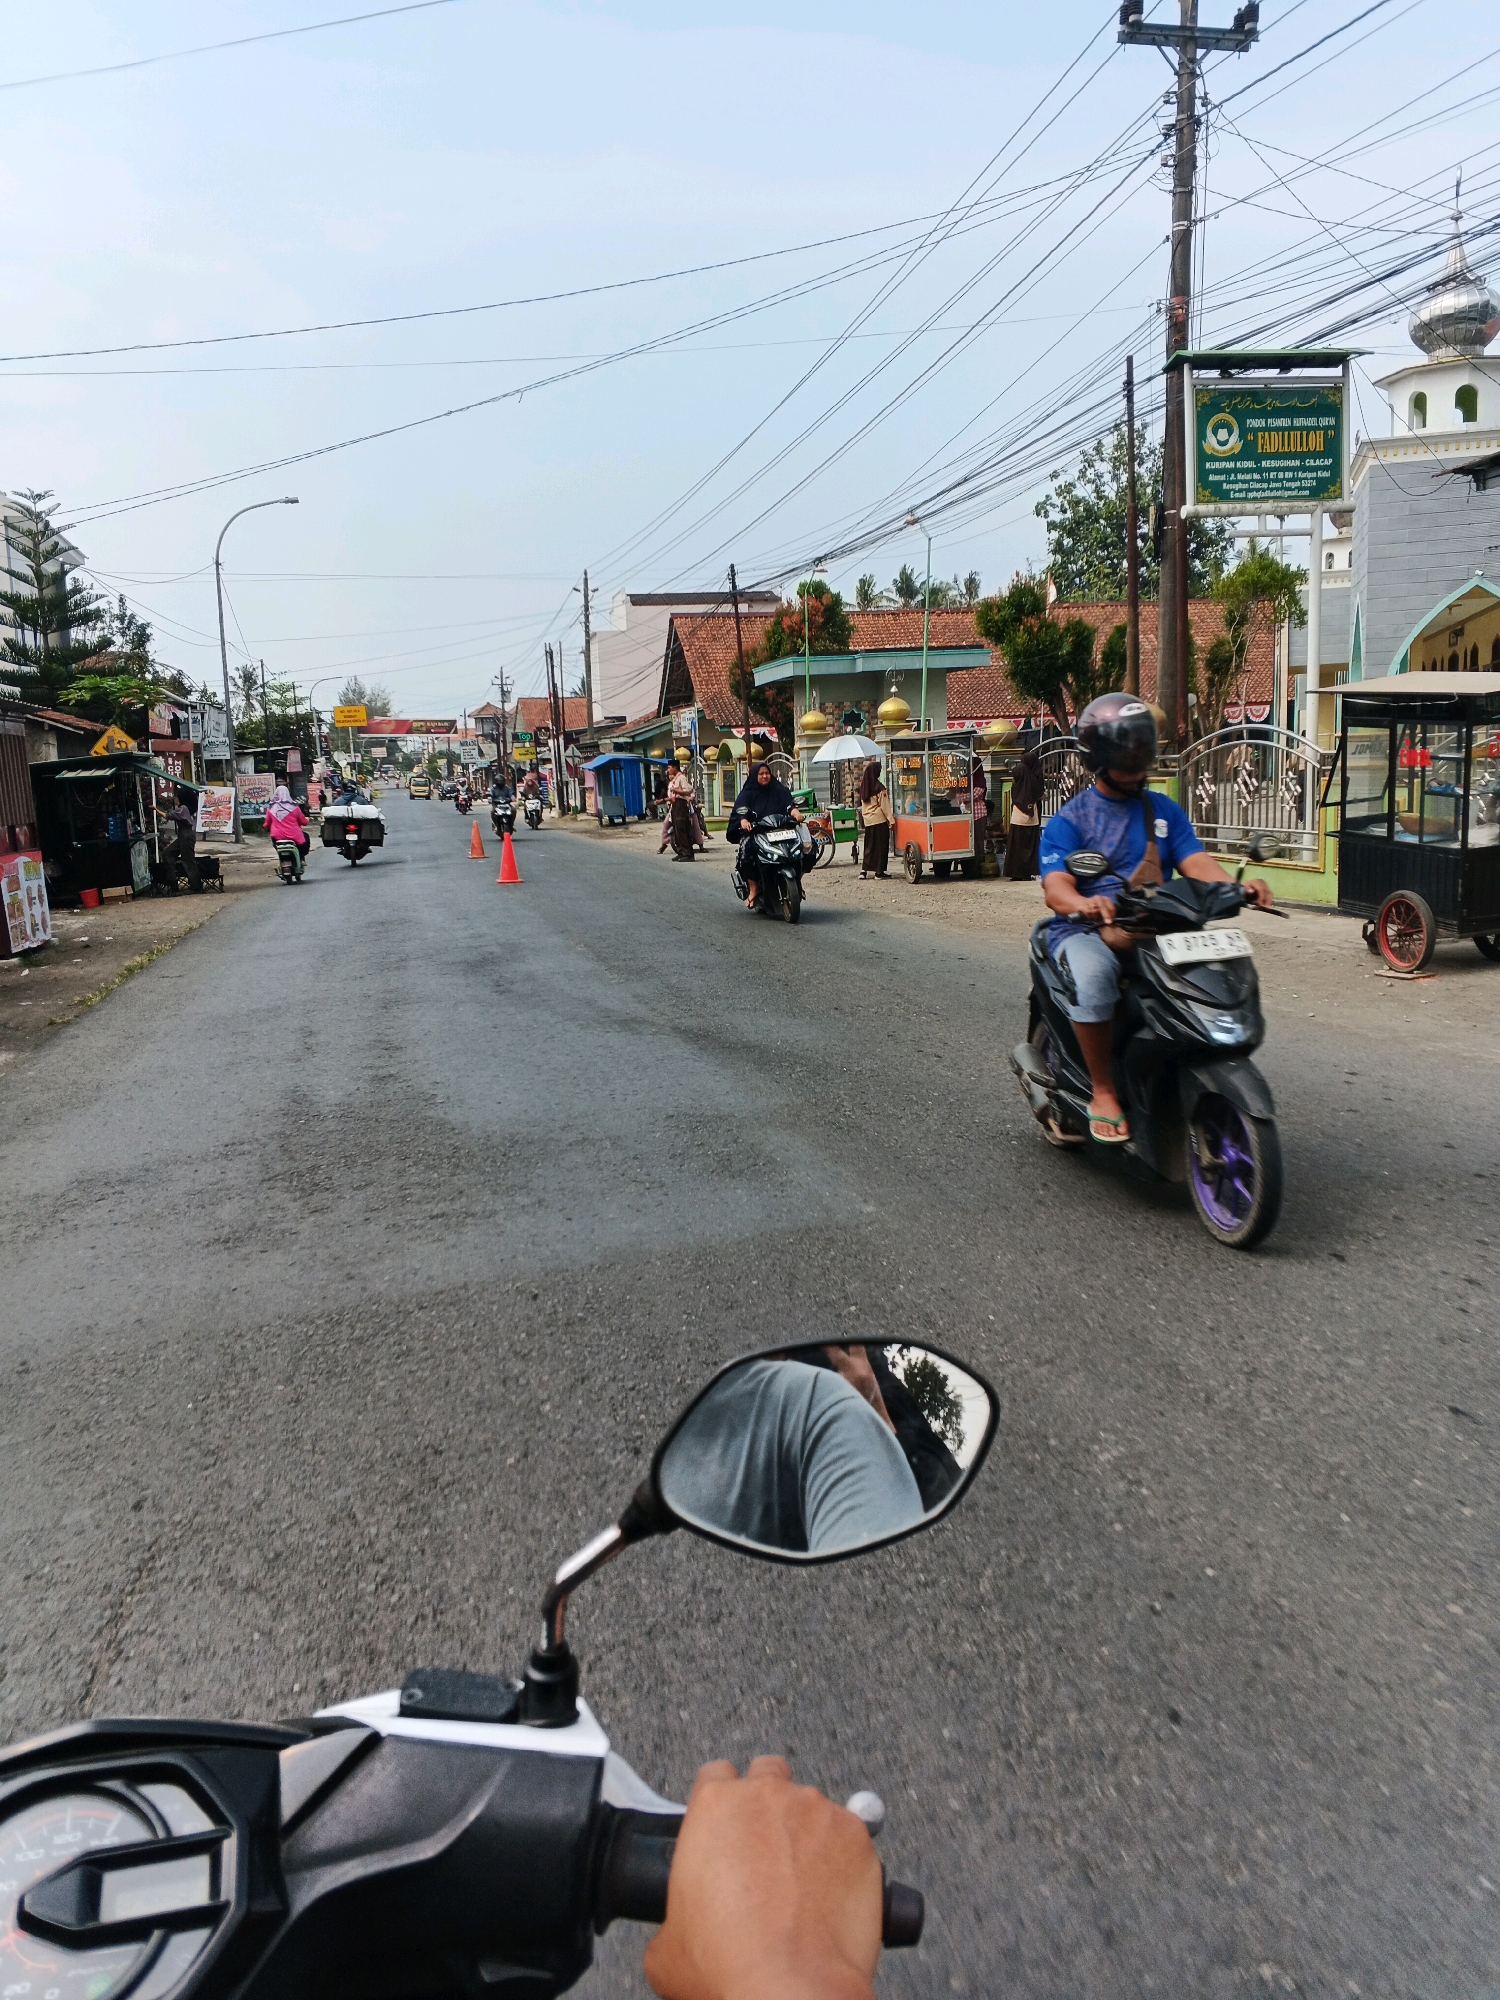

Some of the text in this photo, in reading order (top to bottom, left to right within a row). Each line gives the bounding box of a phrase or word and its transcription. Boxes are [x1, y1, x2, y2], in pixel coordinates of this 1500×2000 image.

[1258, 430, 1325, 453] FADLLULLOH
[1205, 461, 1235, 469] KURIPAN
[1236, 460, 1257, 468] KIDUL
[1261, 459, 1300, 468] KESUGIHAN
[1305, 458, 1333, 466] CILACAP
[1208, 473, 1226, 481] Alamat
[1253, 472, 1261, 480] No.
[1285, 471, 1293, 479] RW
[1298, 471, 1317, 480] Kuripan
[1317, 470, 1331, 478] Kidul
[1223, 482, 1249, 491] Kesugihan
[1249, 481, 1268, 489] Cilacap
[1283, 480, 1301, 489] Tengah
[53, 1832, 82, 1844] 120
